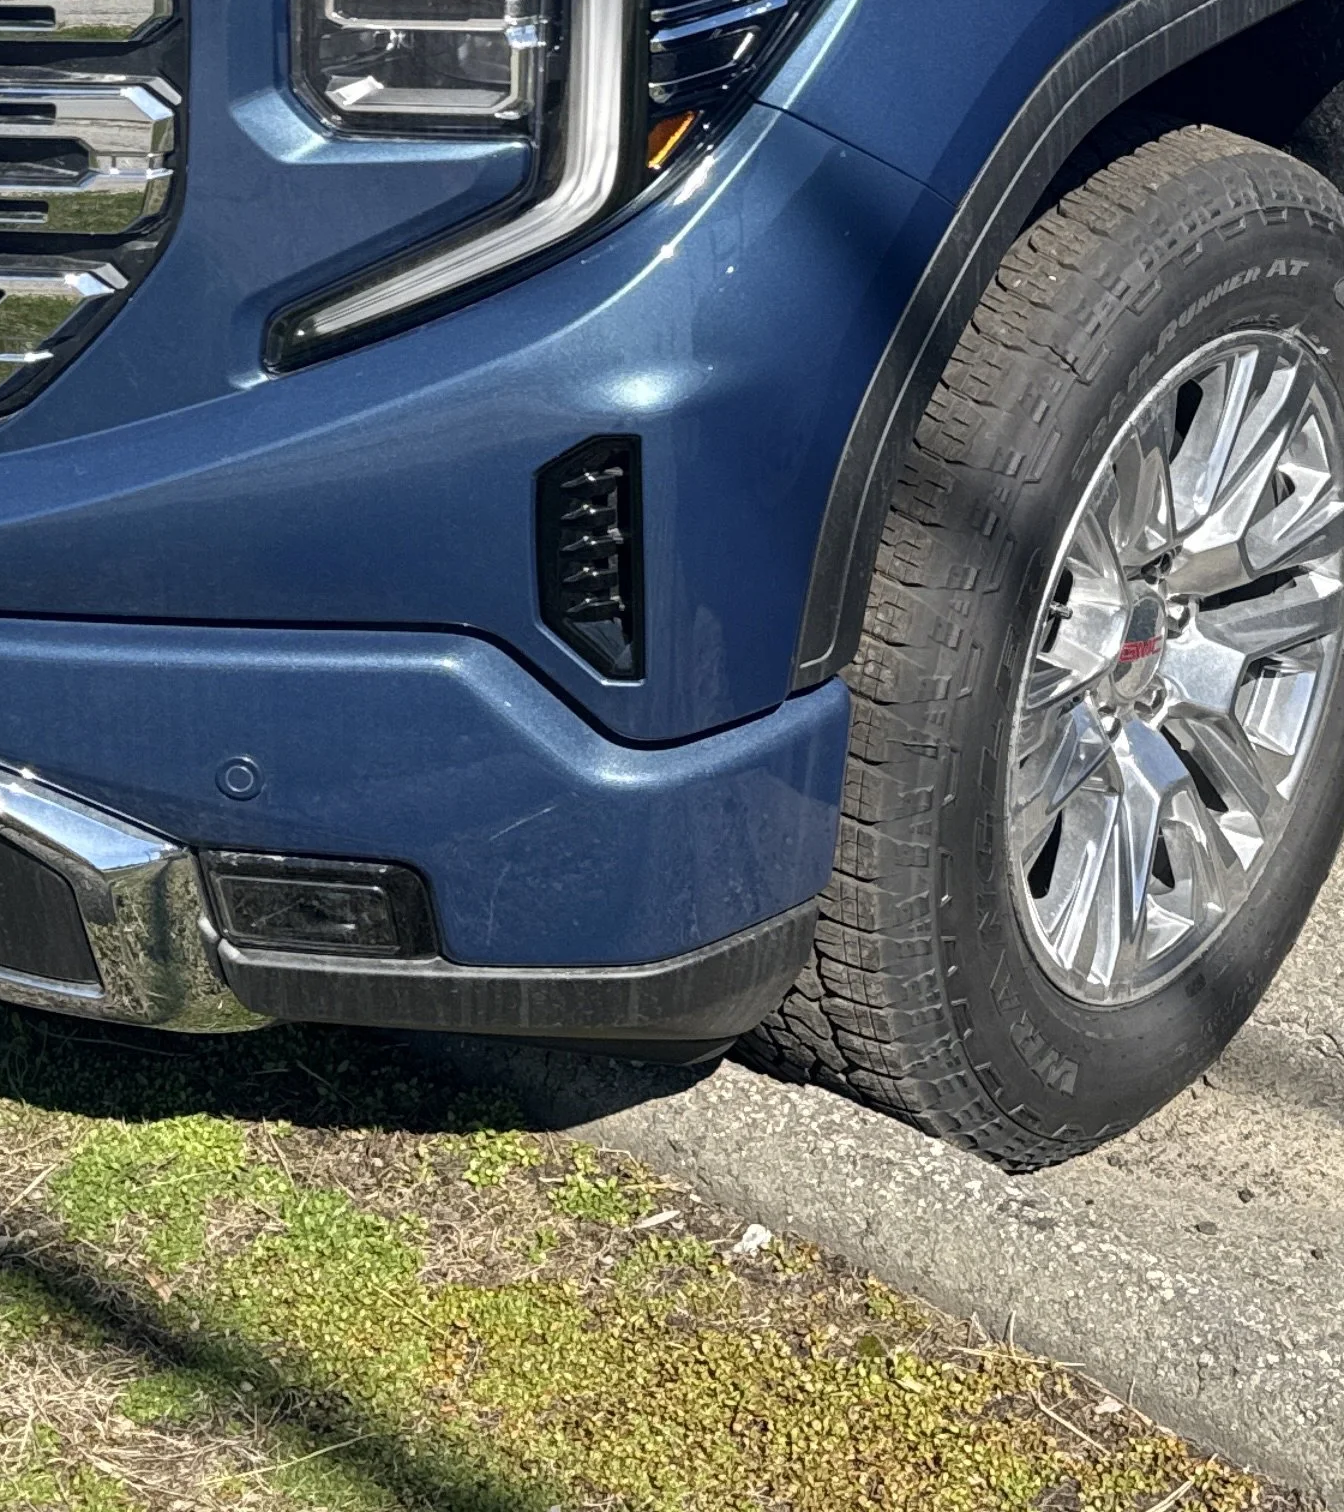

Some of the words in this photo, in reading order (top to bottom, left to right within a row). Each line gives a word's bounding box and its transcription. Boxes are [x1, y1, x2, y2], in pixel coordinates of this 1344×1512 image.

[1070, 349, 1156, 481] TRAIL
[1156, 265, 1262, 356] RUNNER
[1265, 256, 1311, 278] AT
[1119, 635, 1163, 663] GMC
